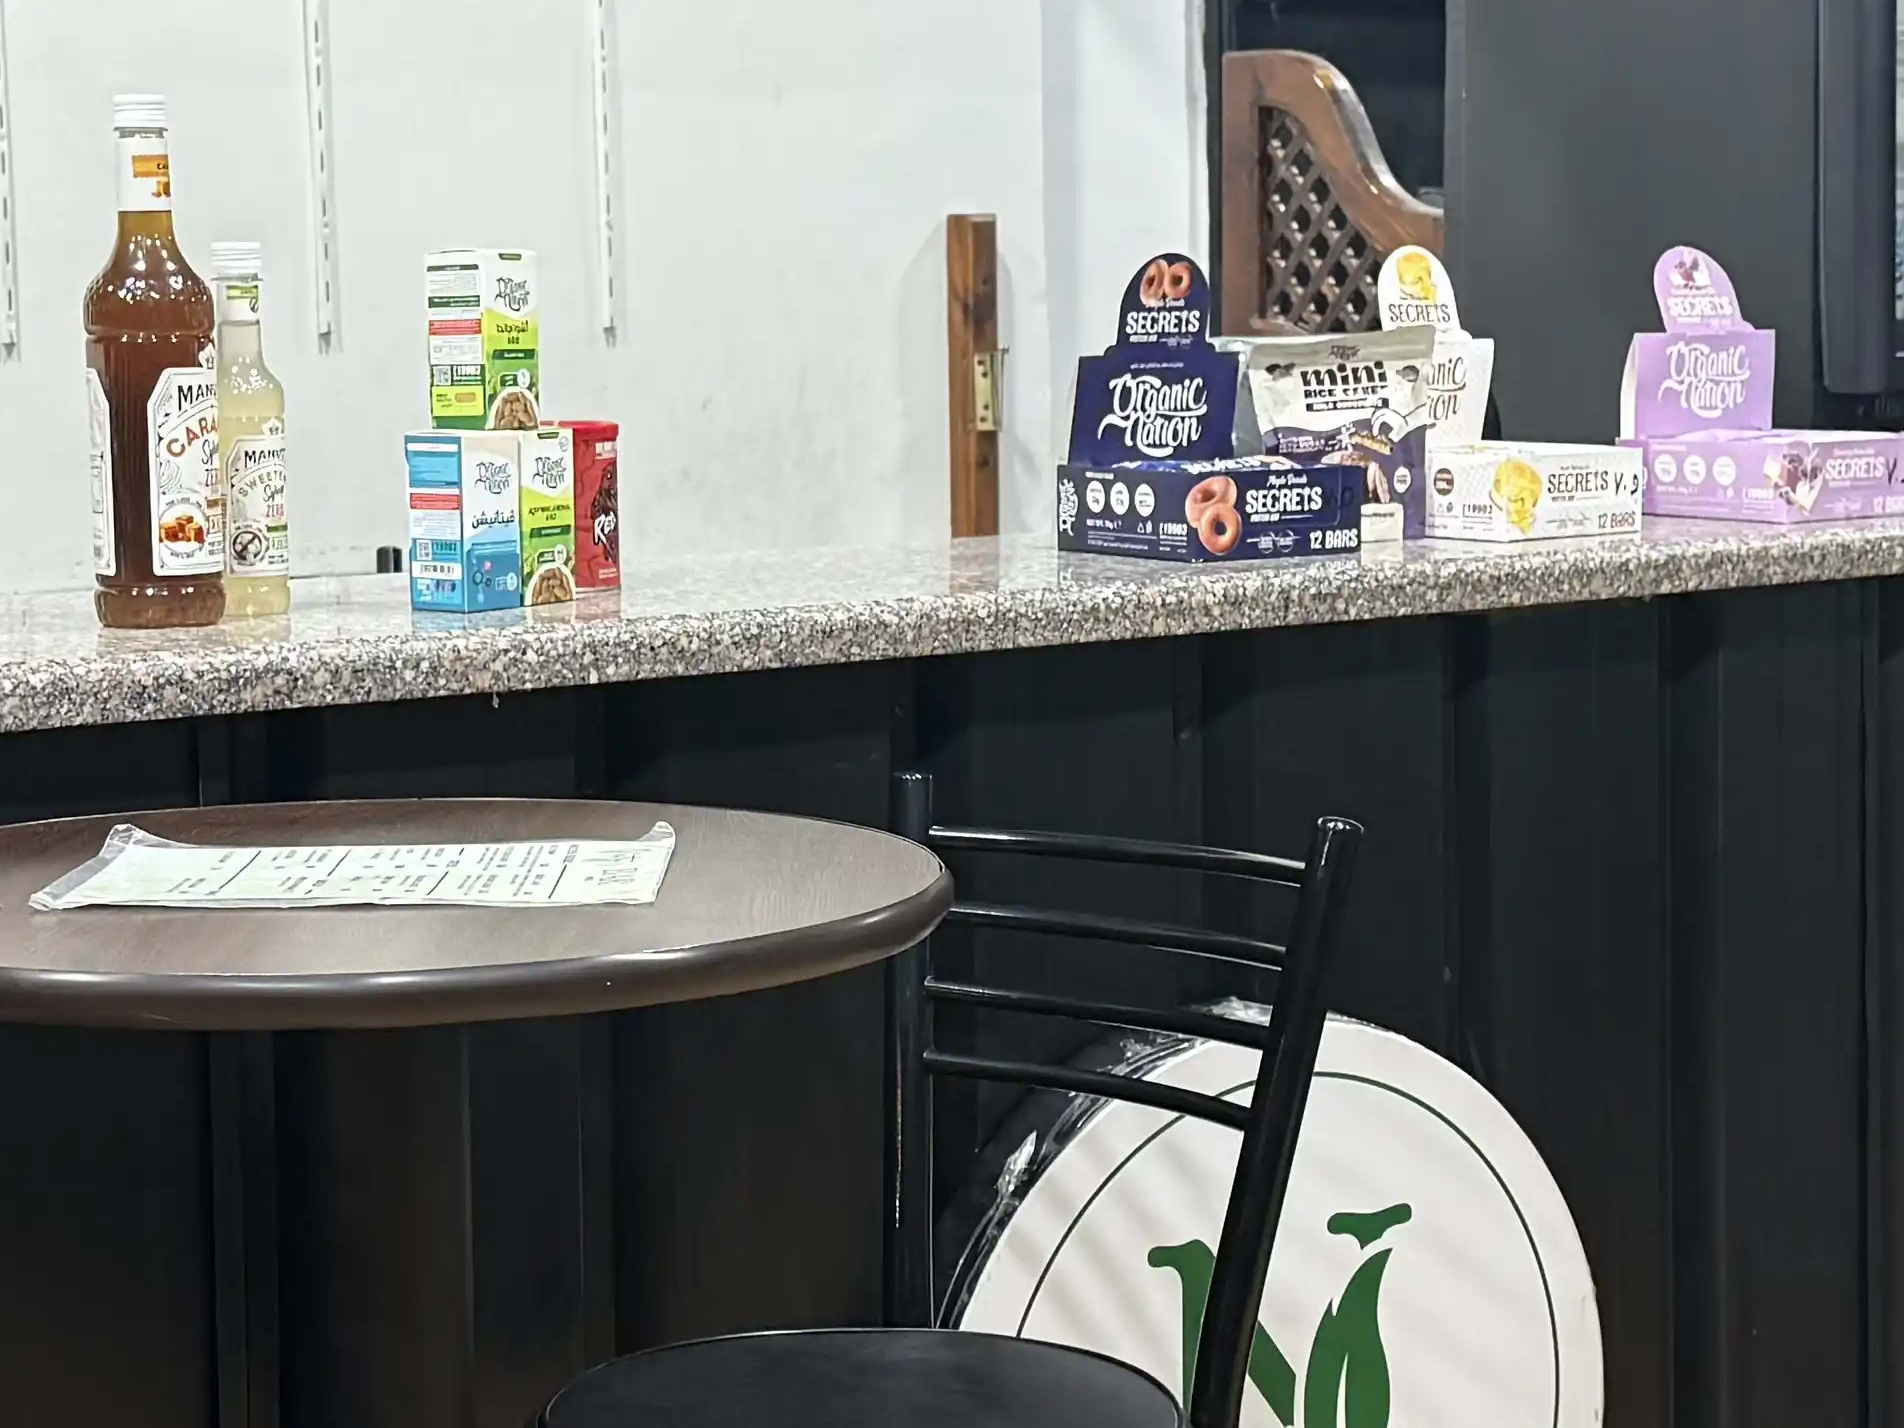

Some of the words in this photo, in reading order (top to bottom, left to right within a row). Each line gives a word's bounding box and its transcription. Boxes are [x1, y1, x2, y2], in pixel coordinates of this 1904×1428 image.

[1125, 310, 1201, 335] SECRETS
[1388, 302, 1452, 324] SECRETS
[1300, 360, 1389, 388] mini
[1665, 341, 1752, 385] Organic
[1108, 373, 1209, 424] Organic
[1303, 388, 1337, 400] RICE
[1657, 376, 1746, 419] Nation
[1097, 409, 1203, 458] Nation
[1825, 456, 1886, 480] SECRETS
[1547, 470, 1609, 494] SECRETS
[1245, 486, 1323, 514] SECRETS
[1873, 496, 1884, 514] 12
[1598, 514, 1609, 529] 12
[1610, 511, 1636, 530] BARS
[1309, 531, 1323, 549] 12
[1325, 528, 1359, 549] BARS
